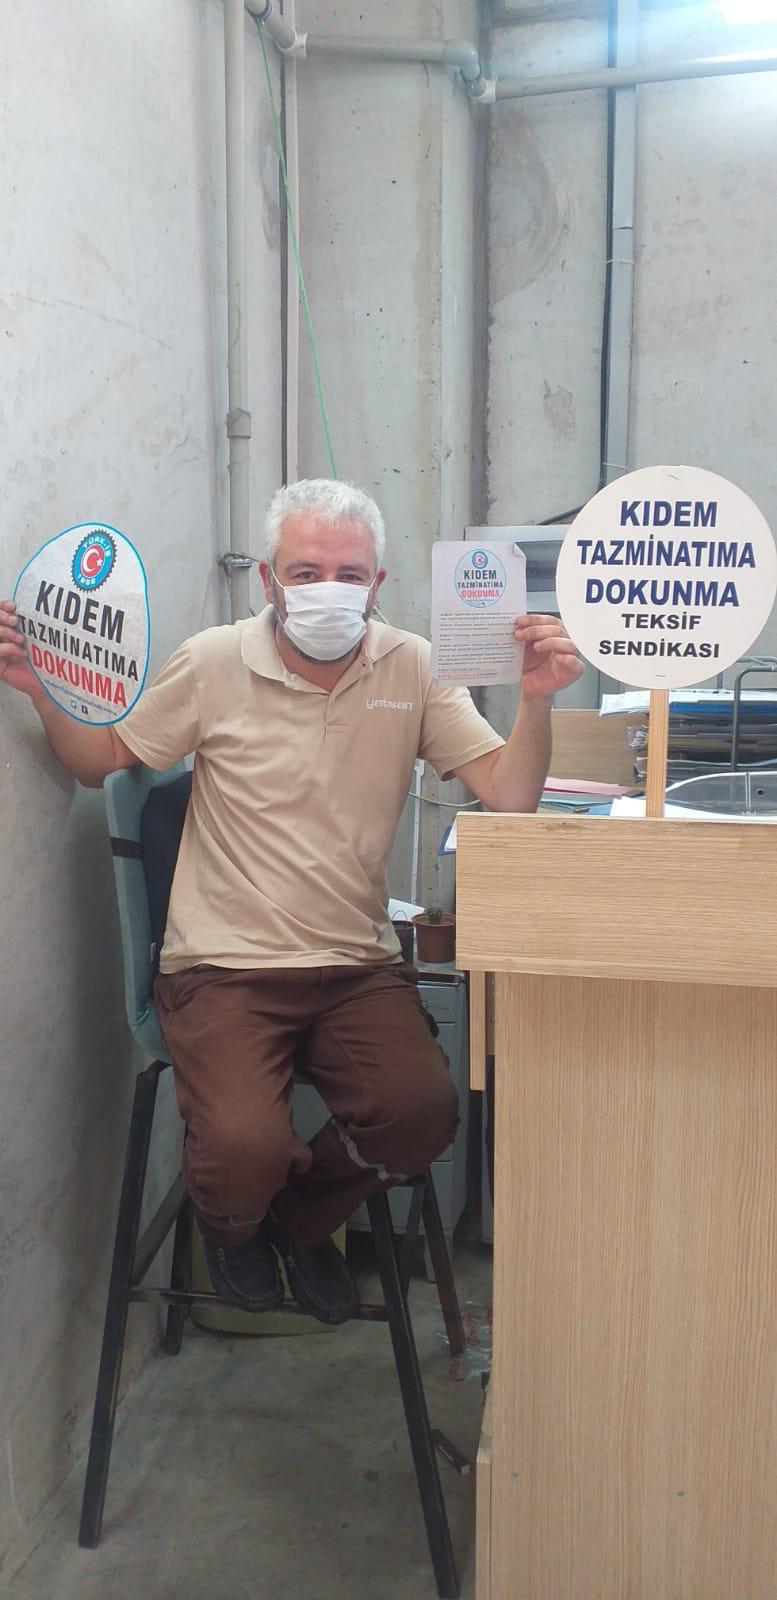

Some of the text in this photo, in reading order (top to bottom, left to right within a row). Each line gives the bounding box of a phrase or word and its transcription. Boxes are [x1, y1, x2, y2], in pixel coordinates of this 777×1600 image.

[620, 500, 718, 528] KIDEM
[577, 534, 757, 568] TAZMİNATIMA
[463, 569, 497, 580] KIDEM
[460, 590, 500, 598] DOKUNMA
[585, 578, 740, 607] DOKUNMA
[35, 580, 125, 644] KIDEM
[621, 611, 702, 630] TEKSİF
[18, 614, 139, 681] TAZMİNATIMA
[598, 638, 720, 658] SENDİKASI
[31, 644, 128, 708] DOKUNMA
[366, 698, 413, 711] yatsan
